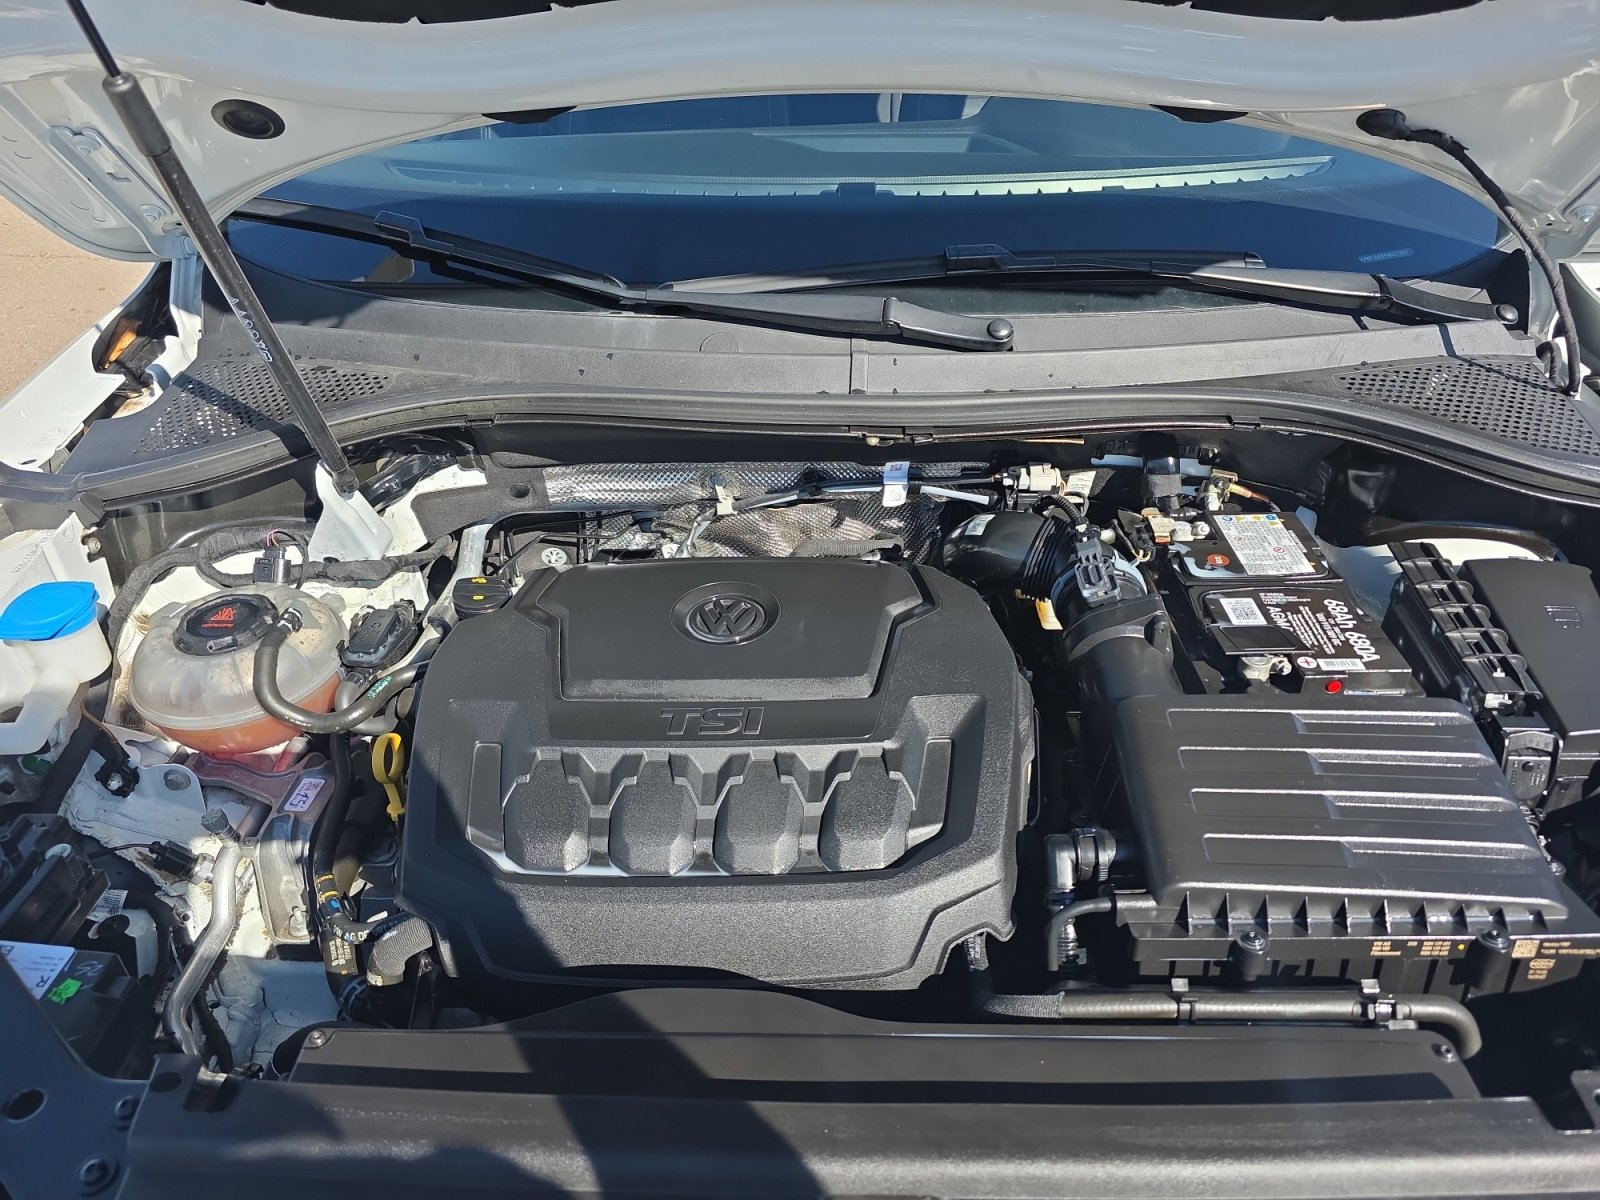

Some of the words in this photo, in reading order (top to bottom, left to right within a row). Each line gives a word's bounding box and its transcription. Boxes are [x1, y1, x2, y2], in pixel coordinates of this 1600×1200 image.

[1323, 599, 1357, 628] 68Ah
[1344, 631, 1381, 662] 680A
[660, 706, 765, 735] TSI
